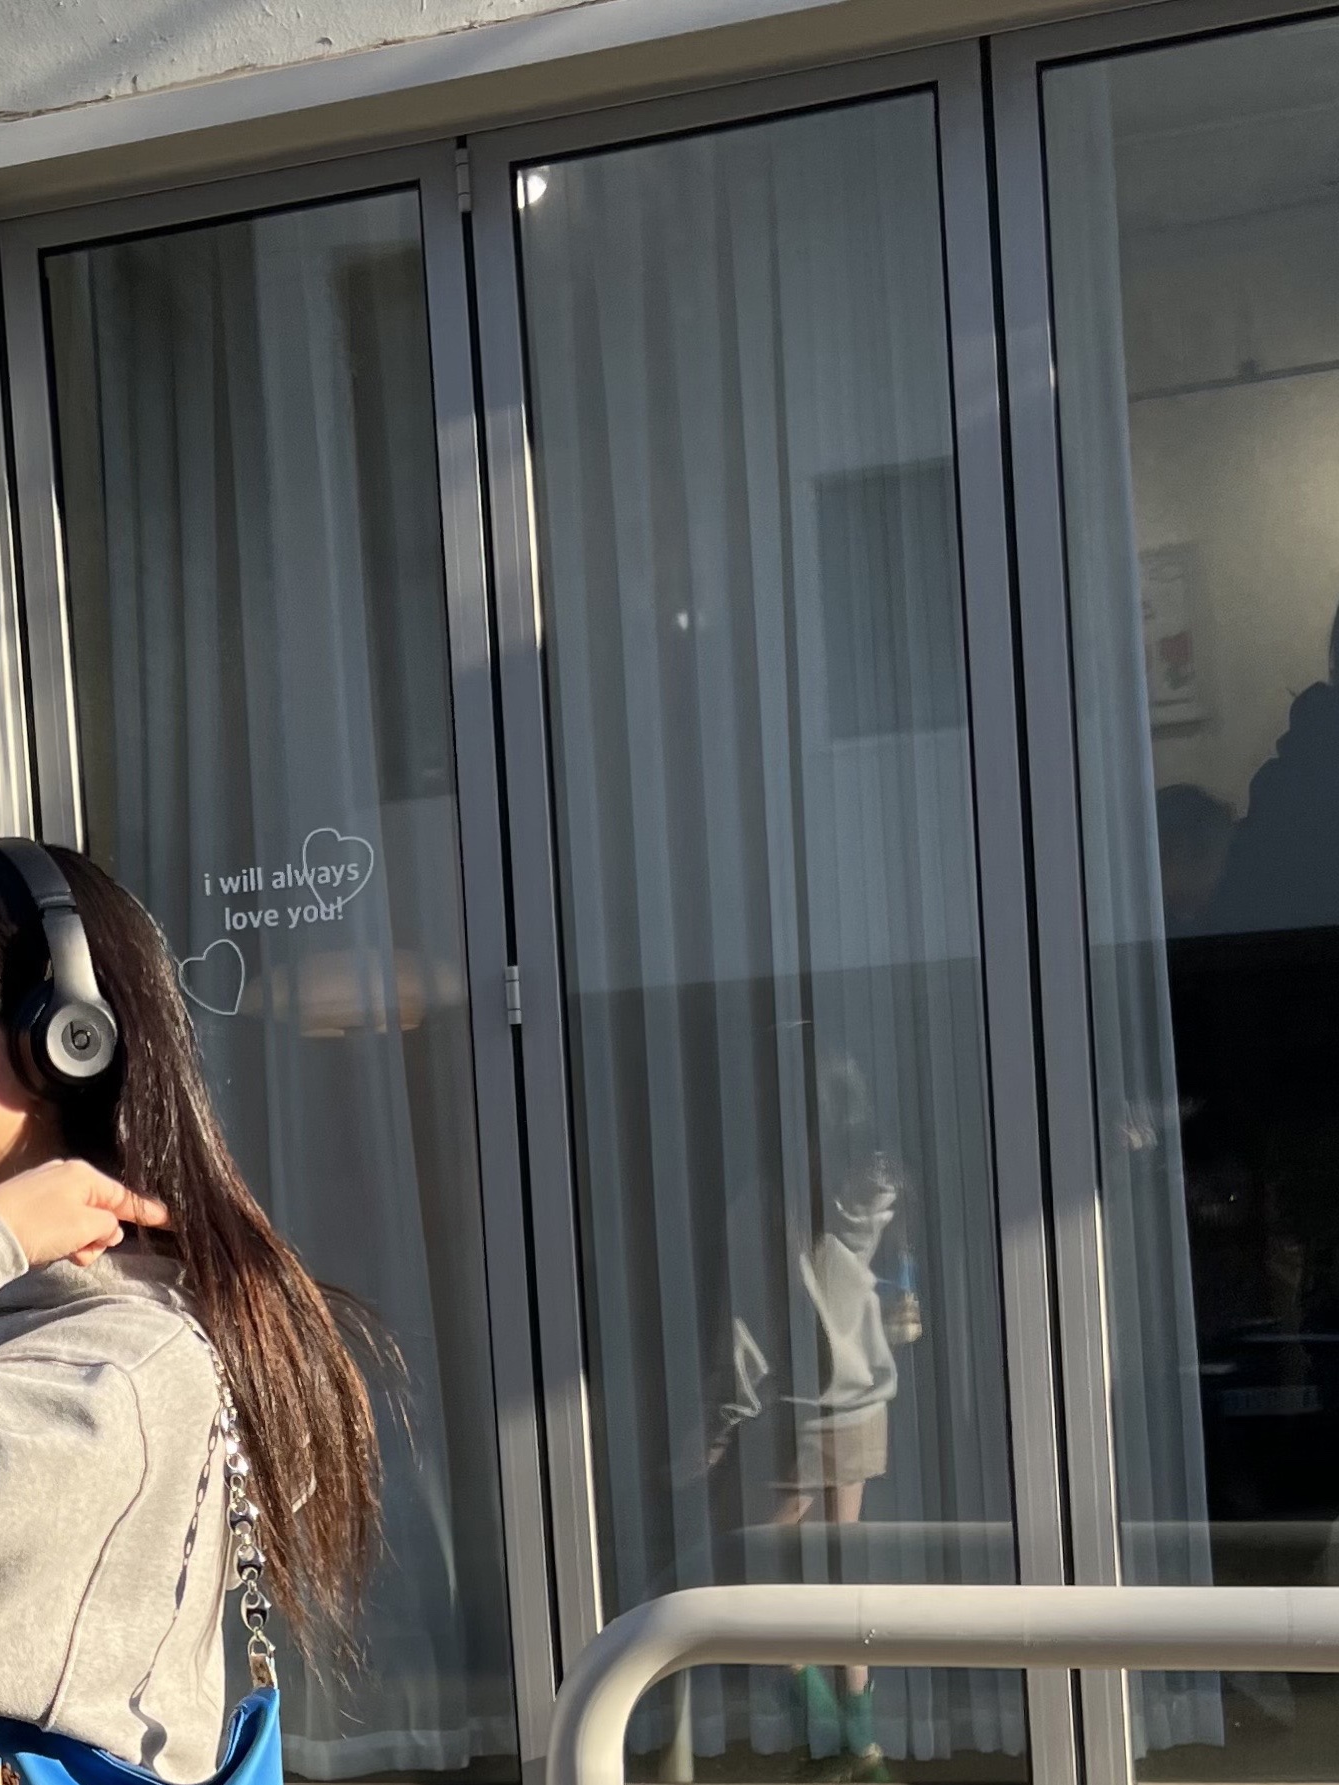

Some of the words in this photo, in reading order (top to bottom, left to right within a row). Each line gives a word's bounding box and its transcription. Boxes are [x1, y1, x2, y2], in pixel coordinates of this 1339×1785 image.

[203, 872, 212, 897] i
[218, 866, 263, 895] will
[271, 863, 360, 890] always
[224, 906, 280, 932] love
[287, 896, 344, 929] you!
